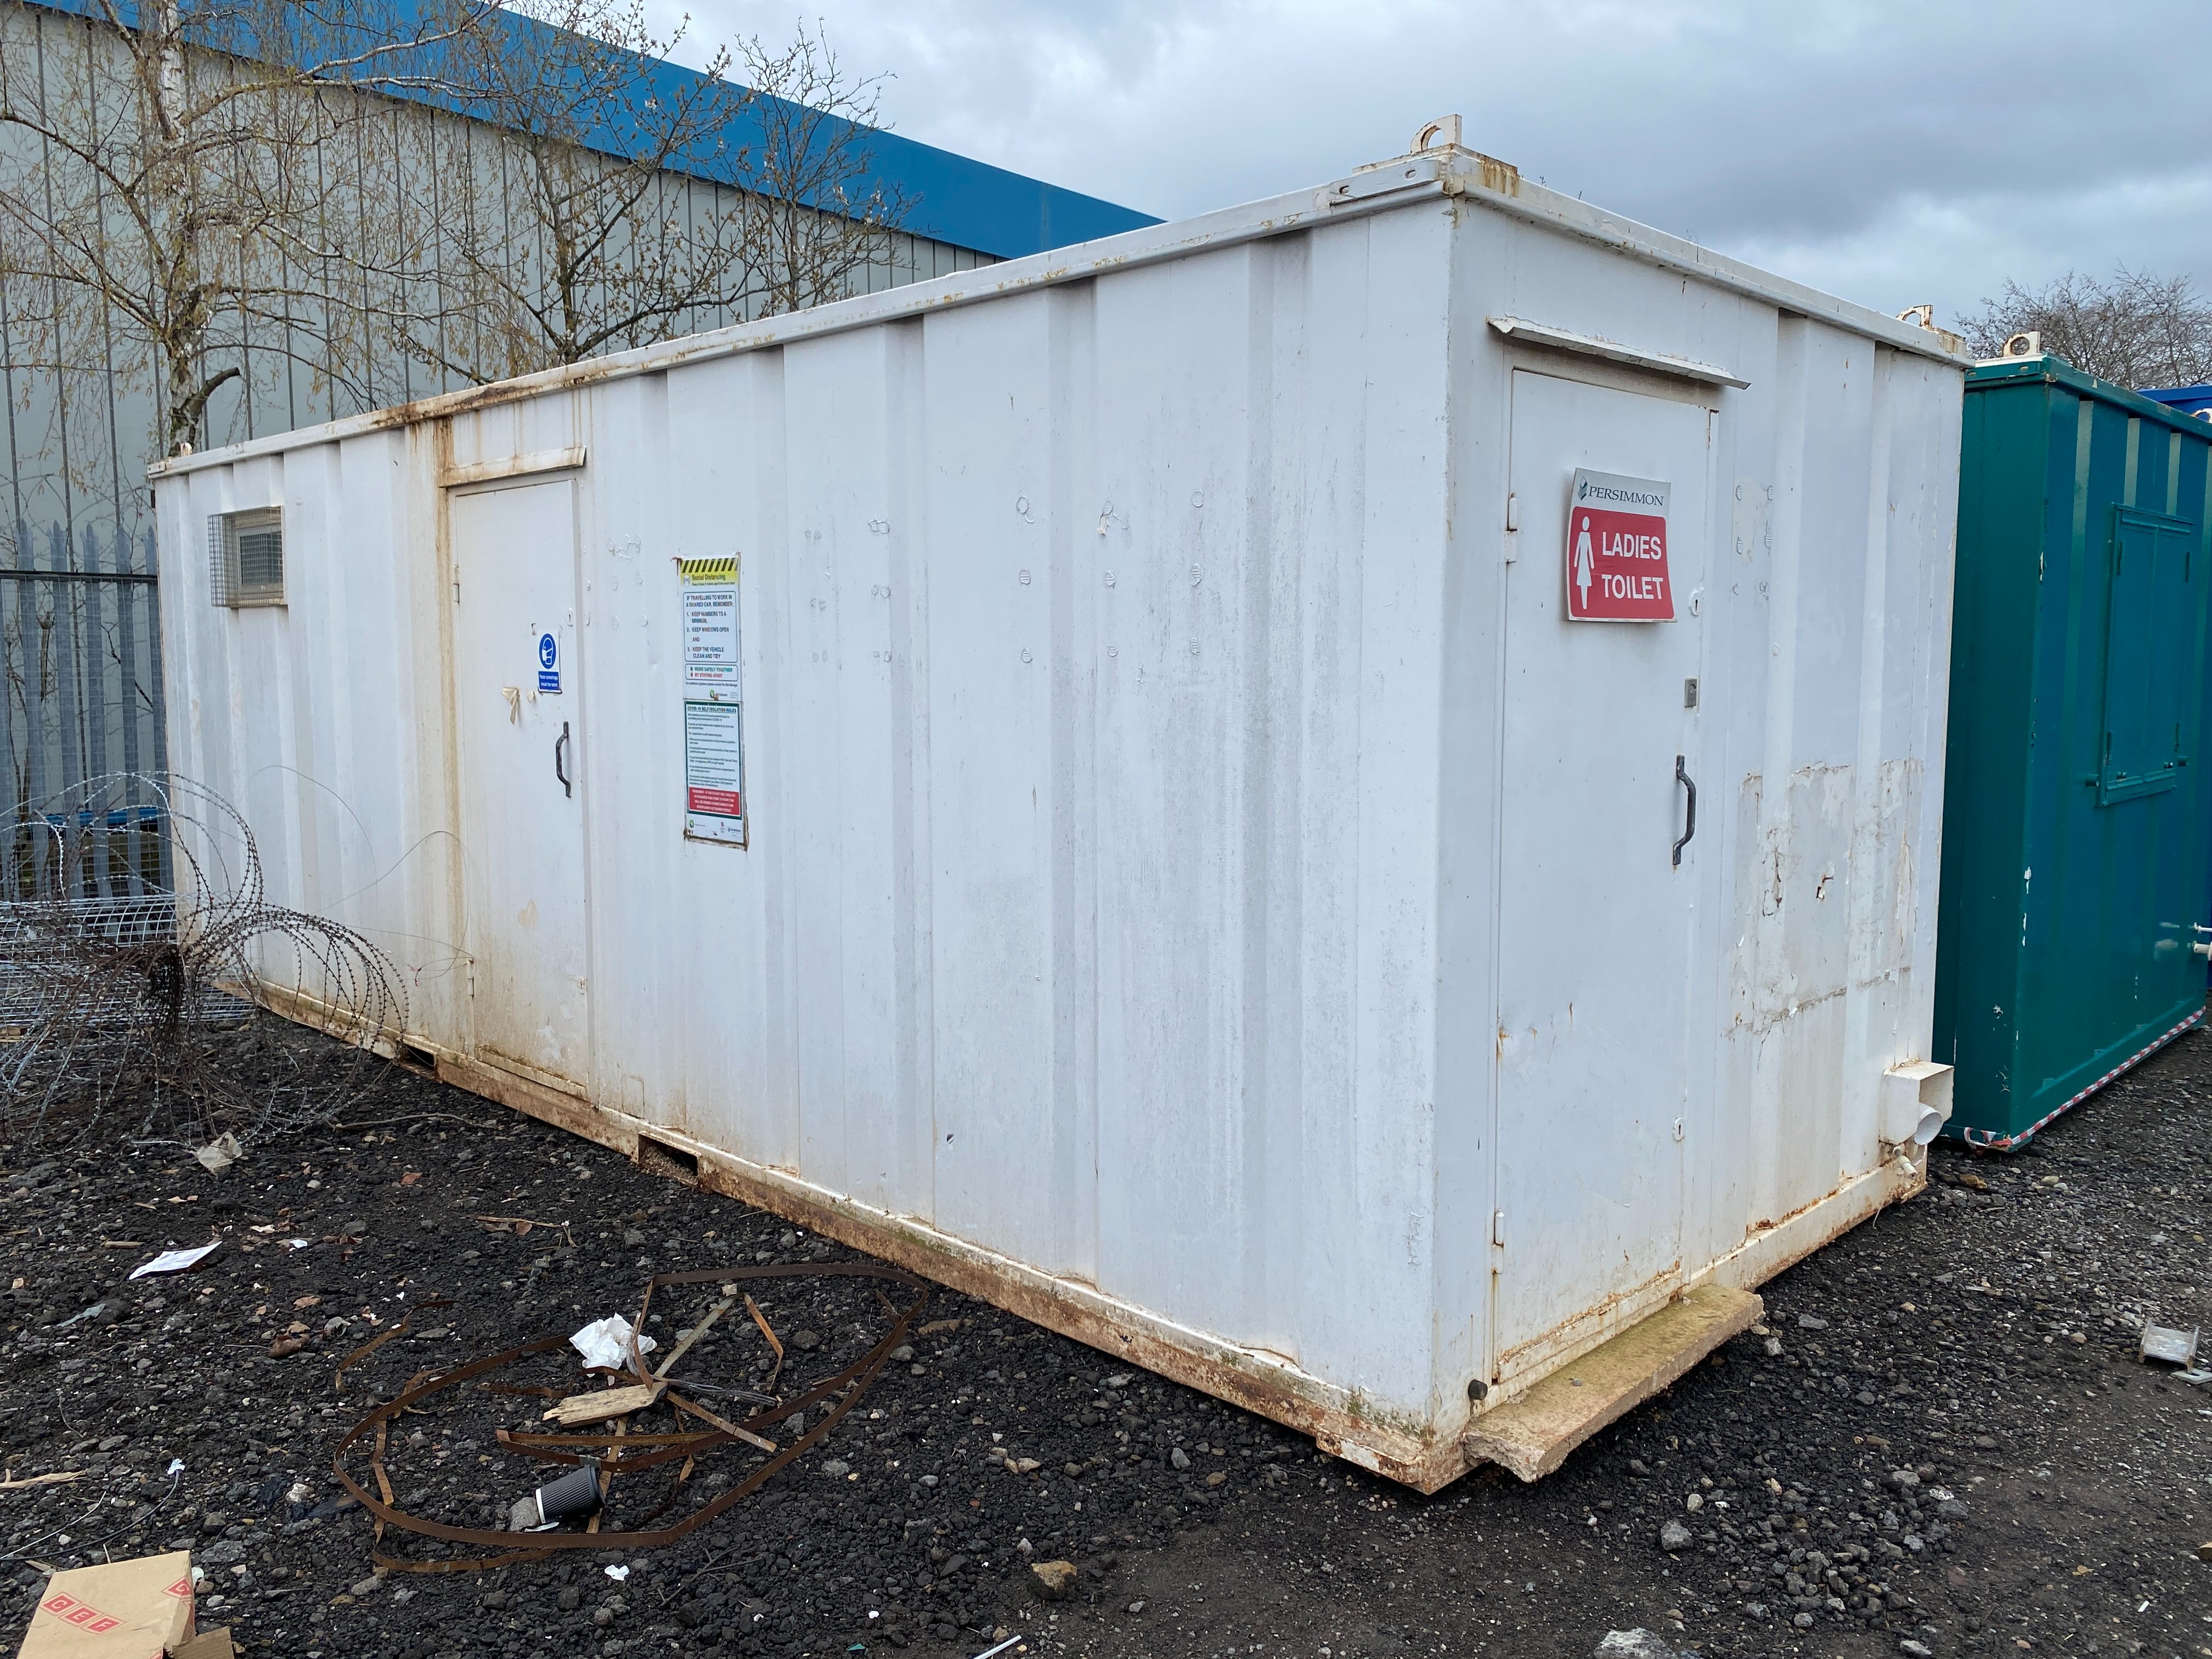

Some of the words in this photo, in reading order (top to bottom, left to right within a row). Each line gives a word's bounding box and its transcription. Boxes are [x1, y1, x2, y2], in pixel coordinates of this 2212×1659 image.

[1589, 486, 1664, 506] PERSIMMON
[1602, 531, 1662, 560] LADIES
[1601, 574, 1664, 600] TOILET
[49, 1598, 114, 1629] CEF
